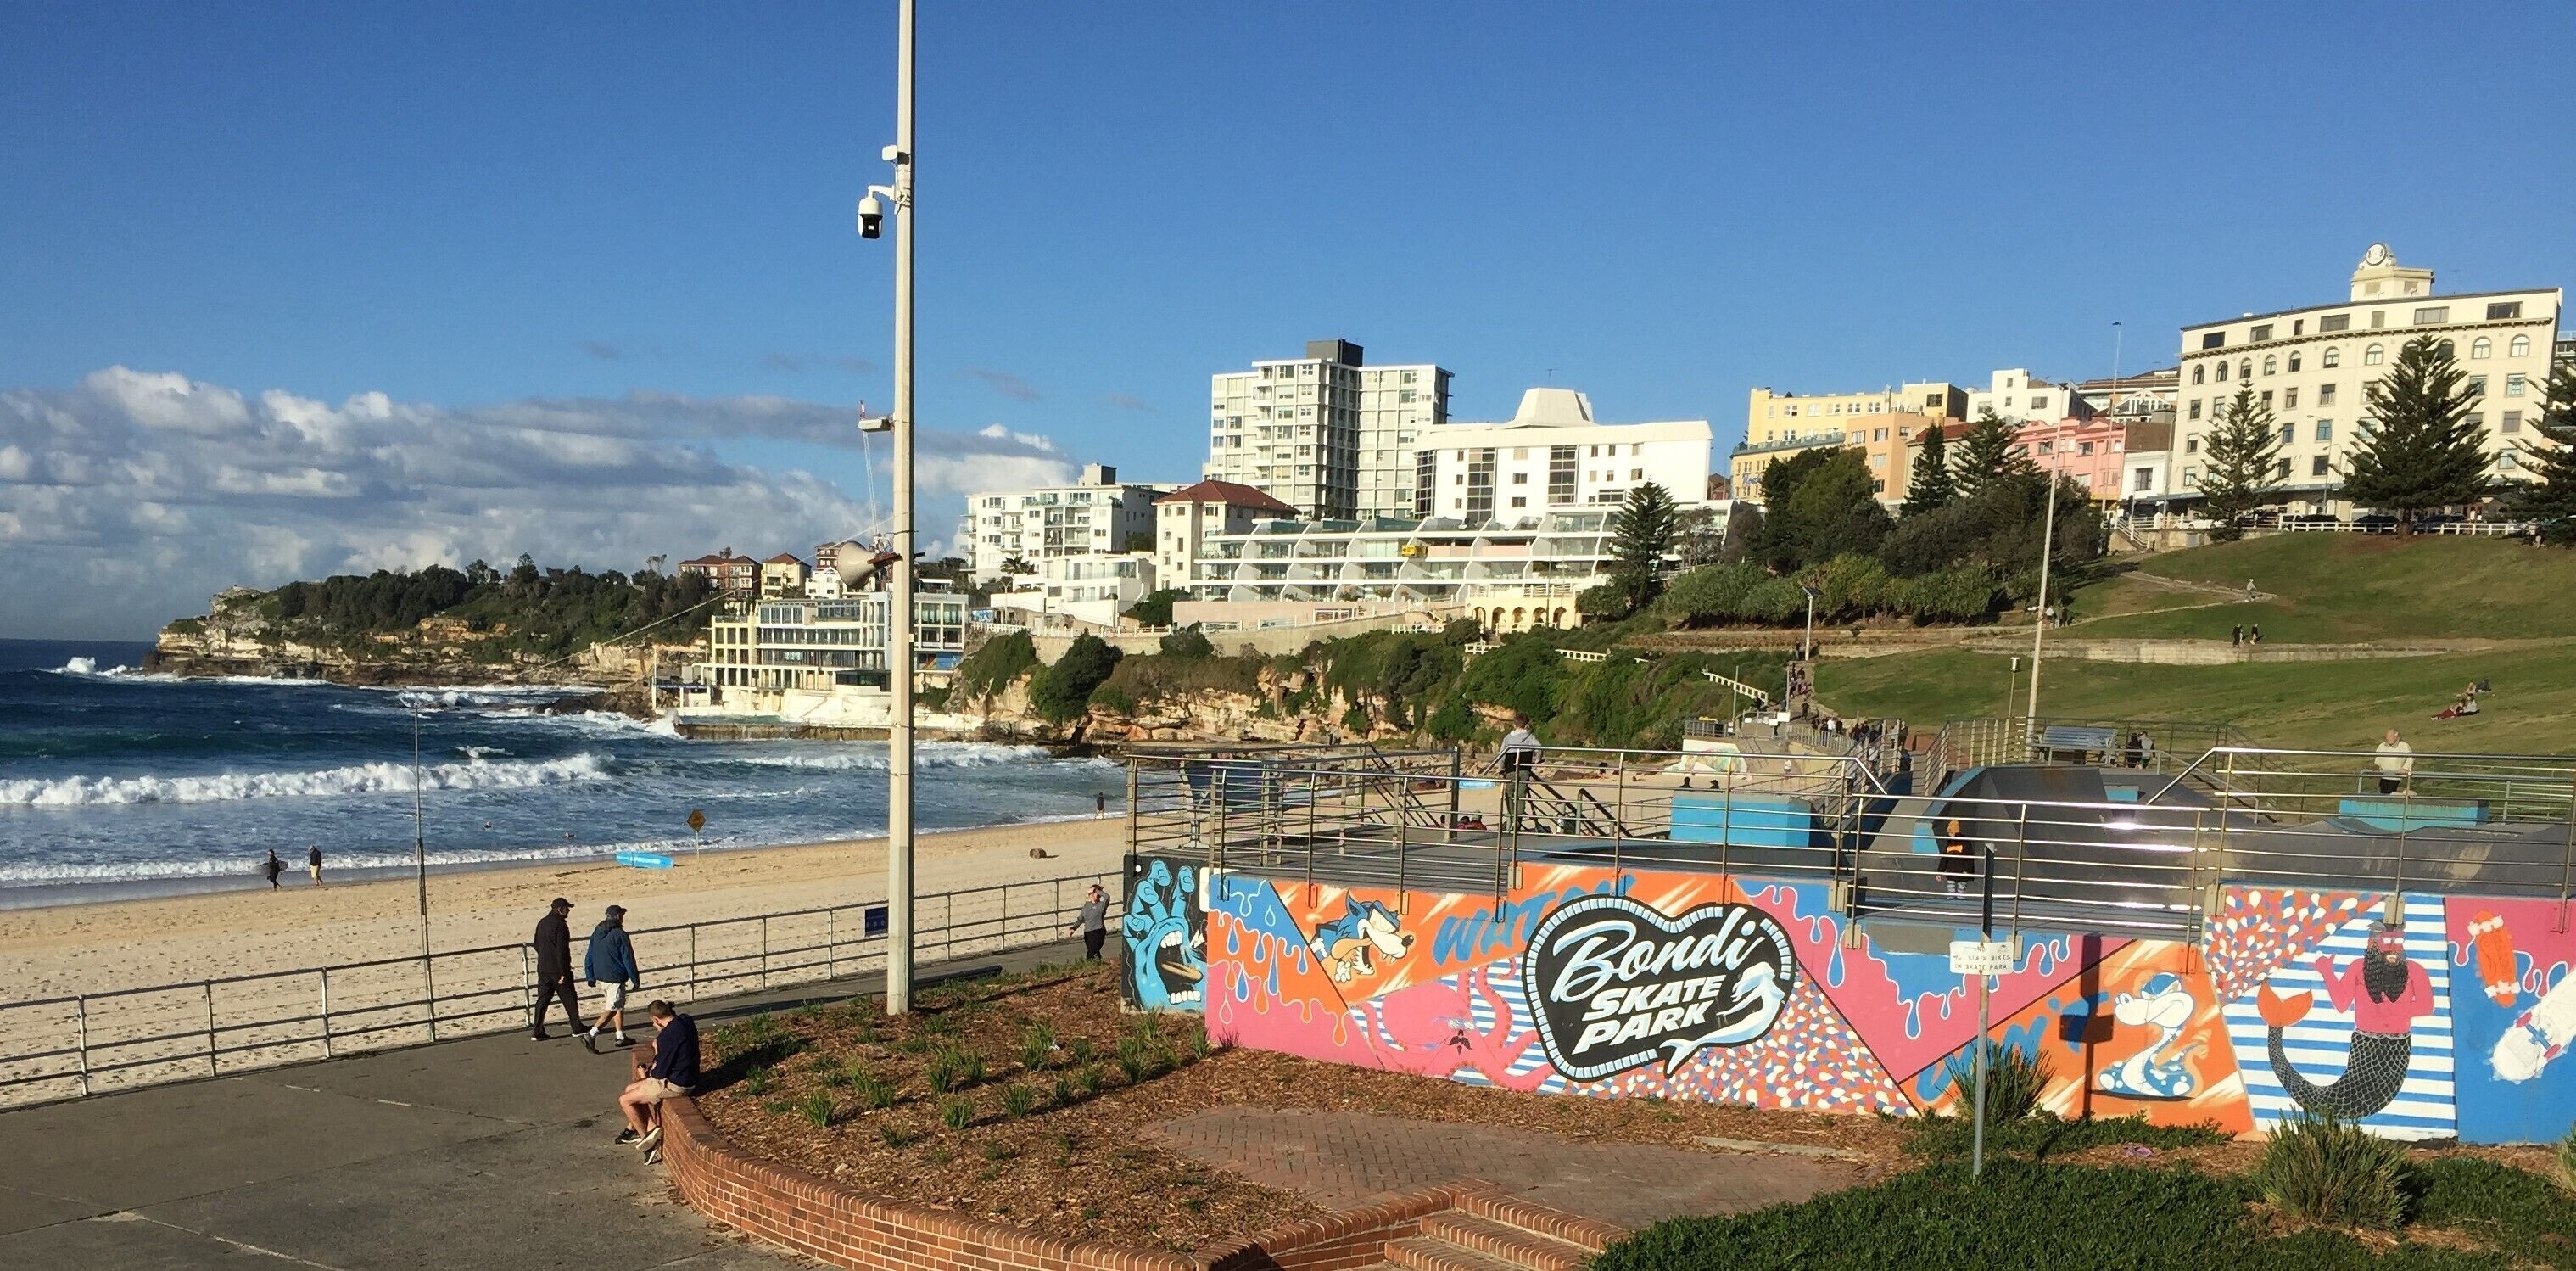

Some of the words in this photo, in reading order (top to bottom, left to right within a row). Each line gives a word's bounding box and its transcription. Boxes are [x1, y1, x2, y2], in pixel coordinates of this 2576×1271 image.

[1550, 907, 1765, 1003] Bondi
[1582, 975, 1726, 1022] SKATE
[1572, 1000, 1715, 1055] PARK
